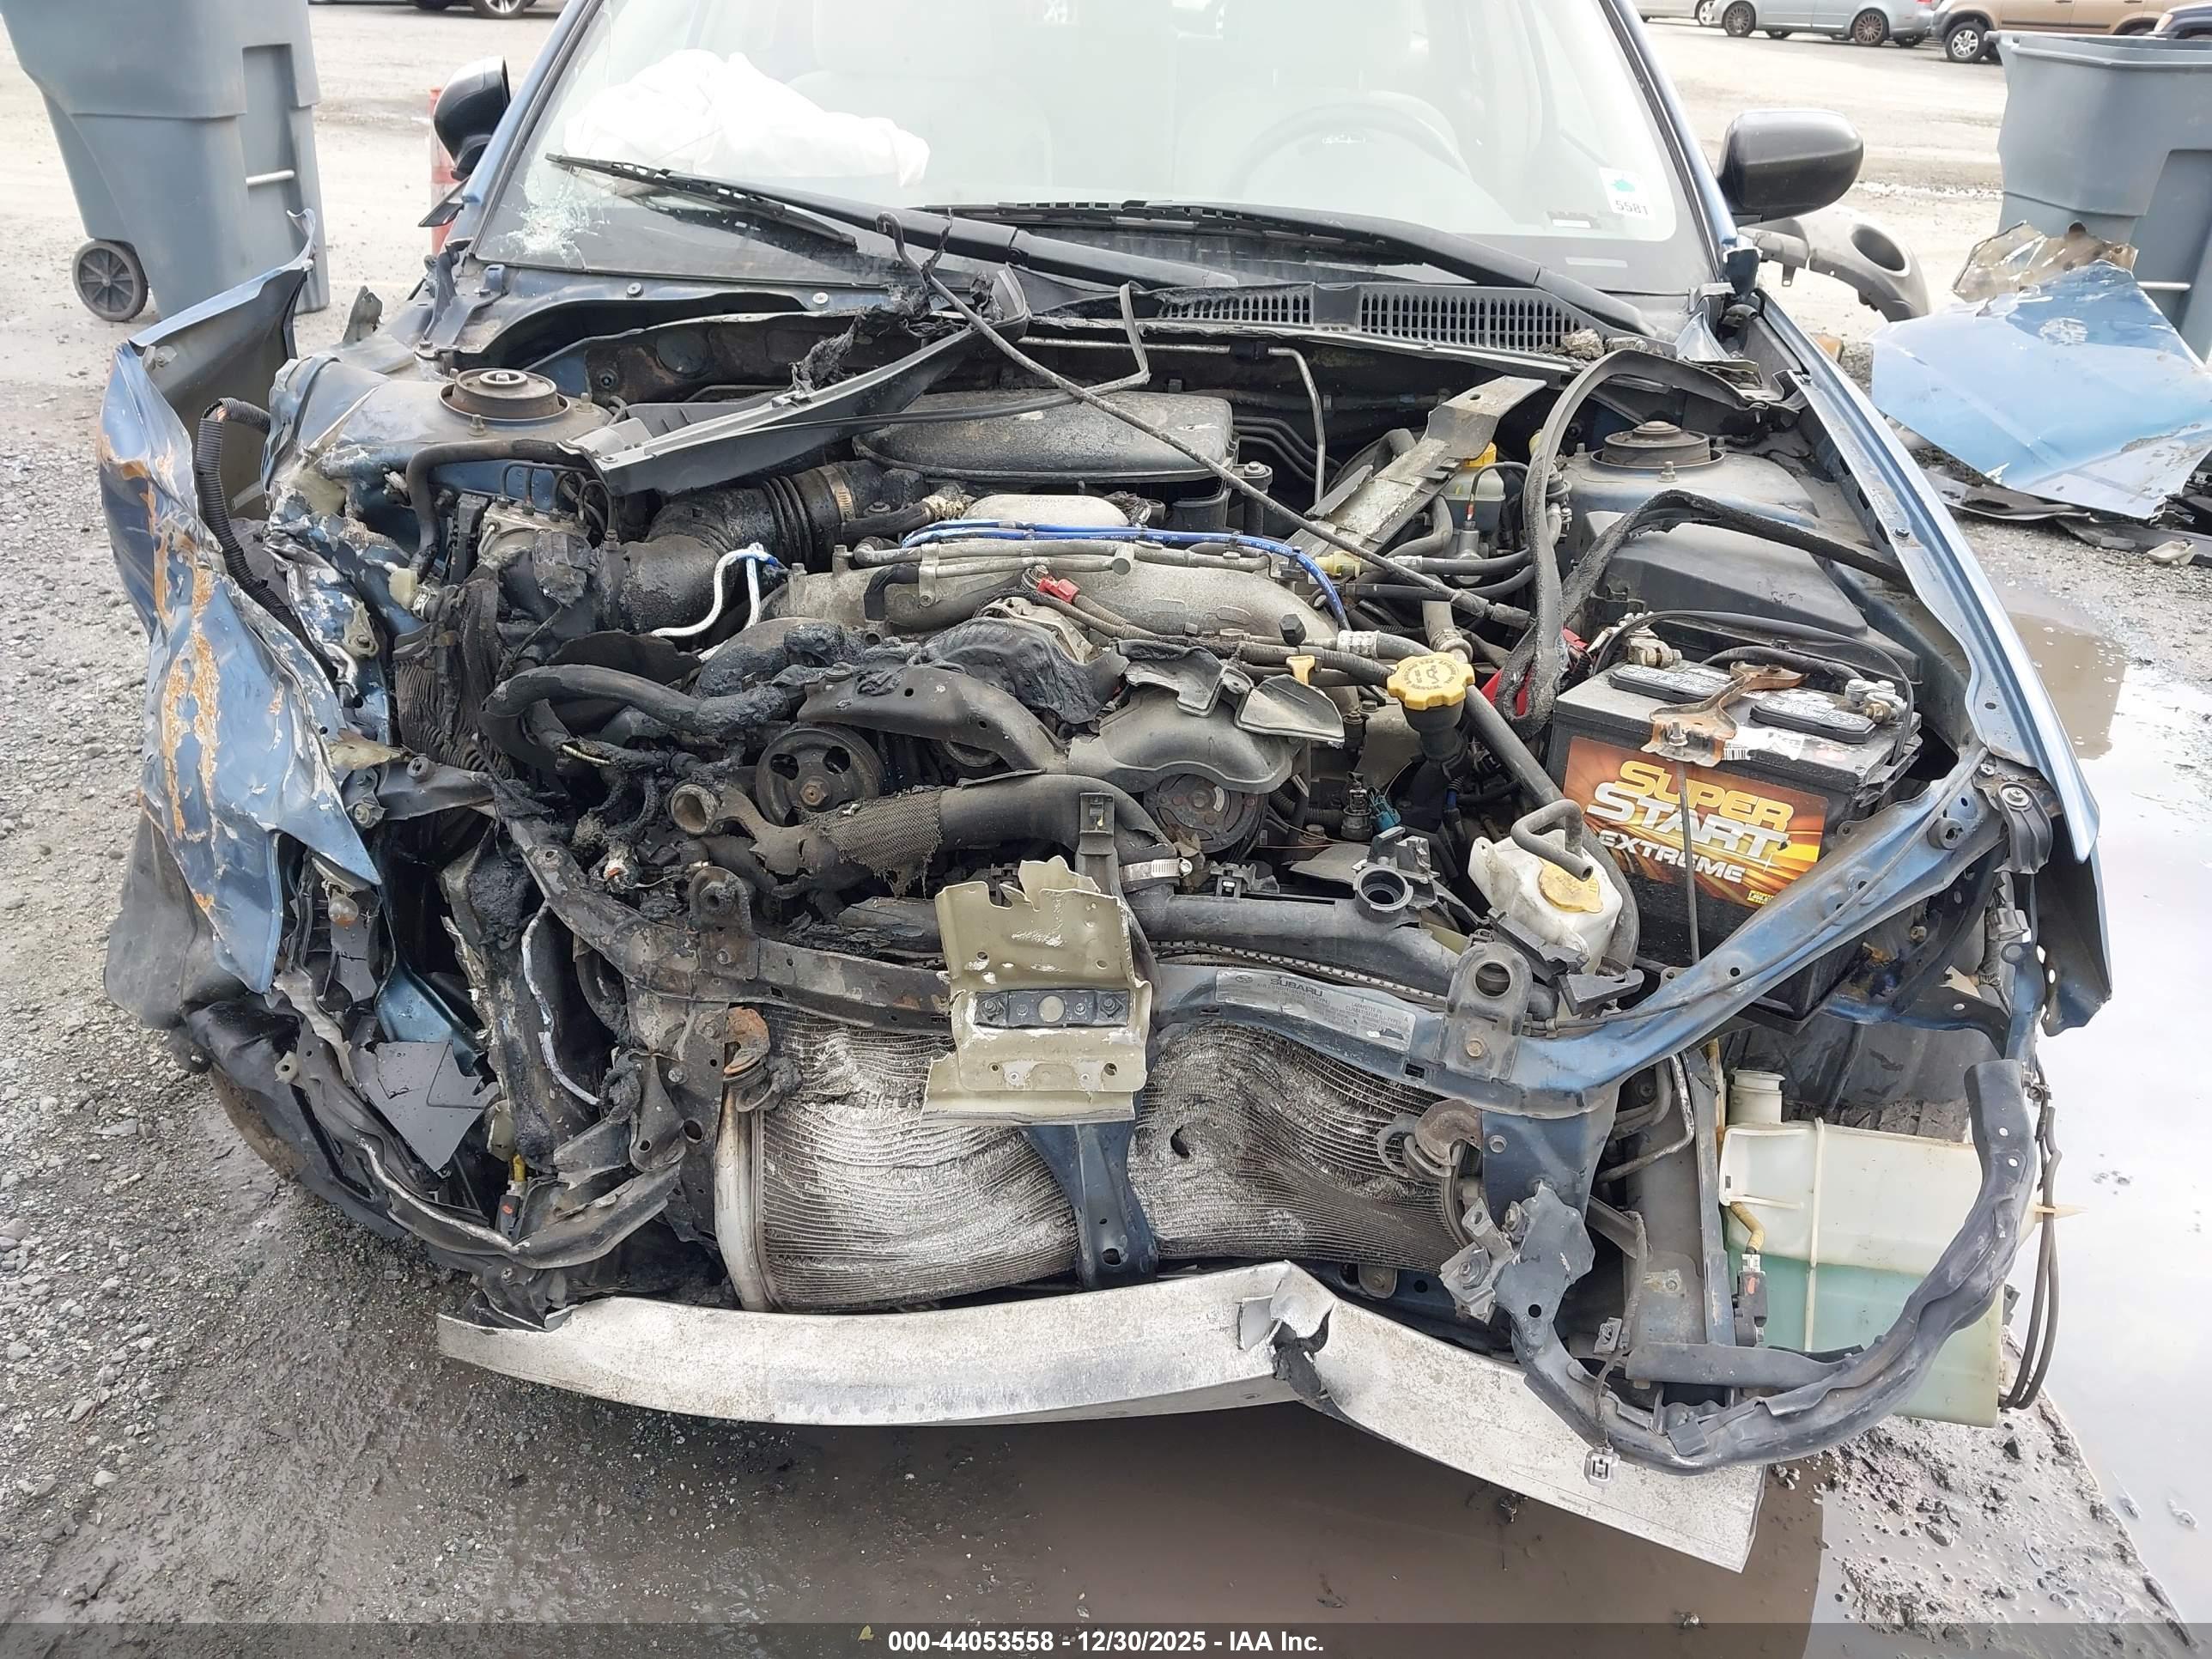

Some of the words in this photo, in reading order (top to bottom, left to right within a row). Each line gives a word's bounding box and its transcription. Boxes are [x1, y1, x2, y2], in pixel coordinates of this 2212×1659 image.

[1614, 199, 1649, 216] 5581
[1614, 760, 1795, 833] SUPER
[1586, 781, 1790, 860] START
[1270, 975, 1323, 997] SUBARU
